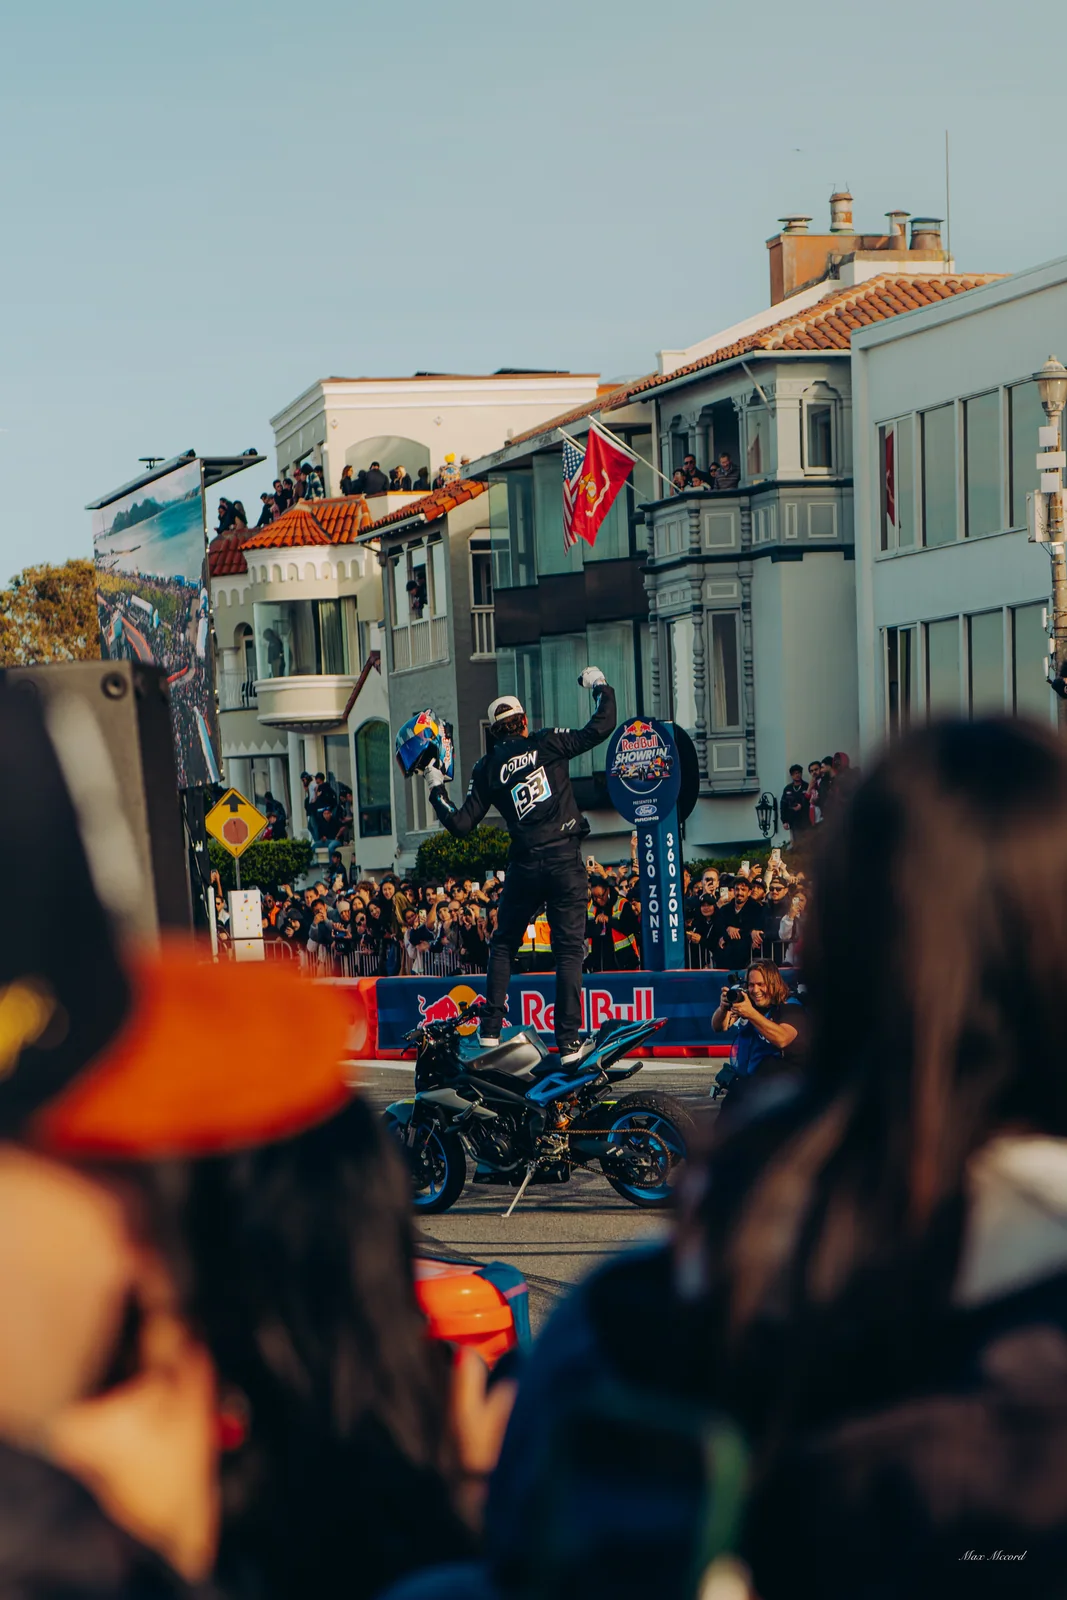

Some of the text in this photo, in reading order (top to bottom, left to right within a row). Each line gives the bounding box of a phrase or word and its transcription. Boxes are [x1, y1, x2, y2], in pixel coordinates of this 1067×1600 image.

[615, 747, 668, 765] SHOWRUN
[622, 734, 659, 752] Red Bull
[515, 775, 546, 813] 93
[645, 834, 660, 943] 360 ZONE
[666, 832, 679, 942] 360 ZONE
[521, 986, 655, 1034] Re Bull
